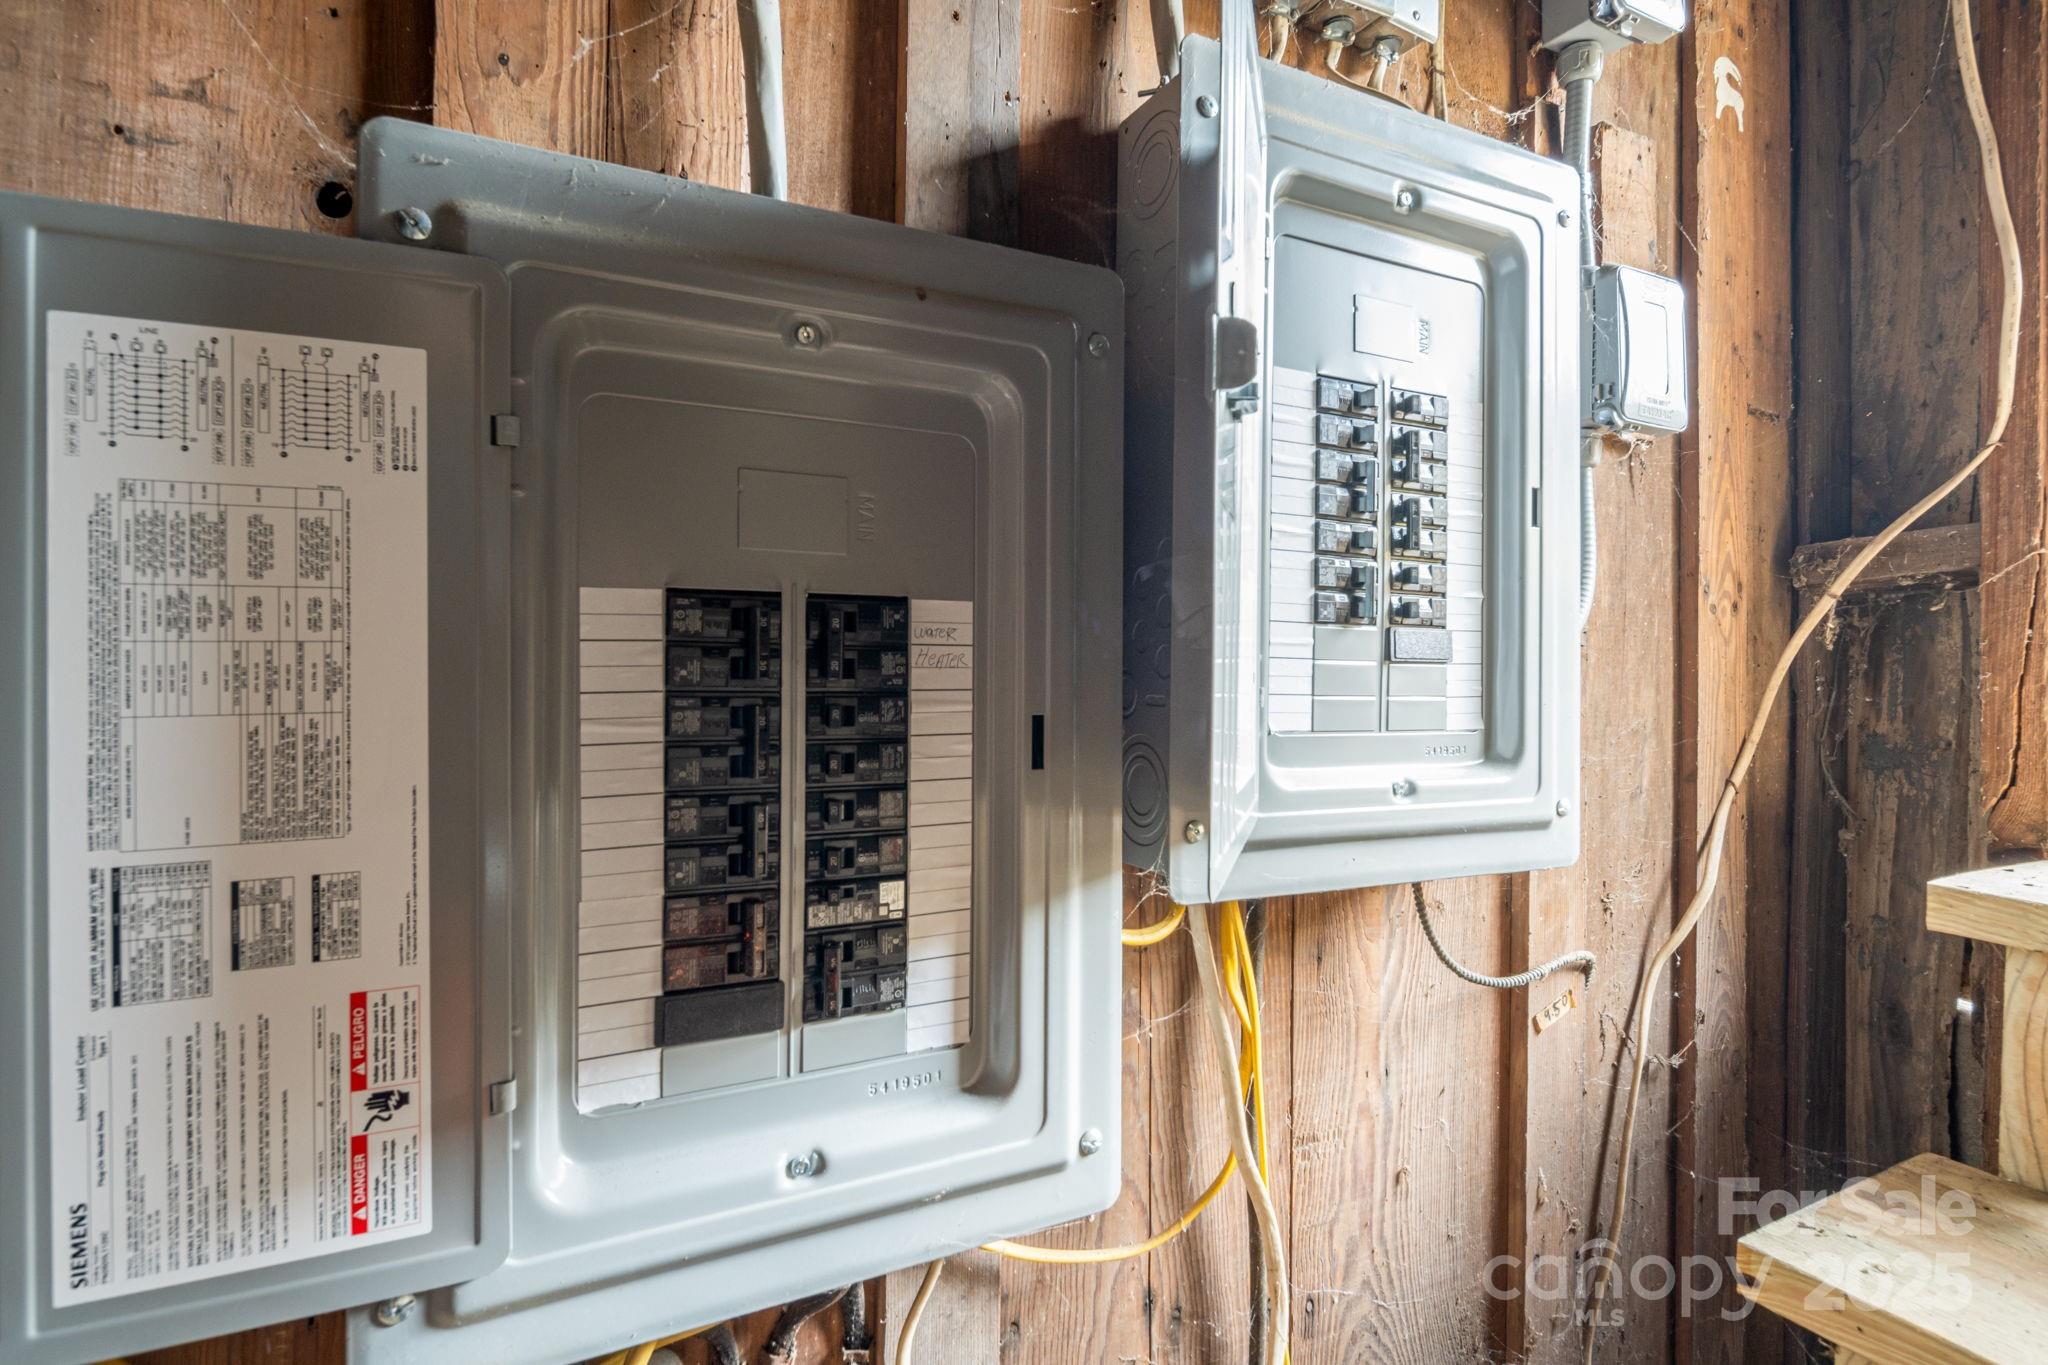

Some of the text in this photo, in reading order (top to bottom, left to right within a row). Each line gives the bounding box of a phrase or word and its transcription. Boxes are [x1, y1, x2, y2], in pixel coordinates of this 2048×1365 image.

[1418, 318, 1430, 355] MAIN
[857, 494, 875, 541] MAIN
[353, 1008, 365, 1060] PELIGRO
[76, 1036, 86, 1122] Indoor Load Center
[868, 1070, 941, 1096] 5419501
[354, 1154, 365, 1204] DANGER
[70, 1203, 88, 1290] SIEMENS
